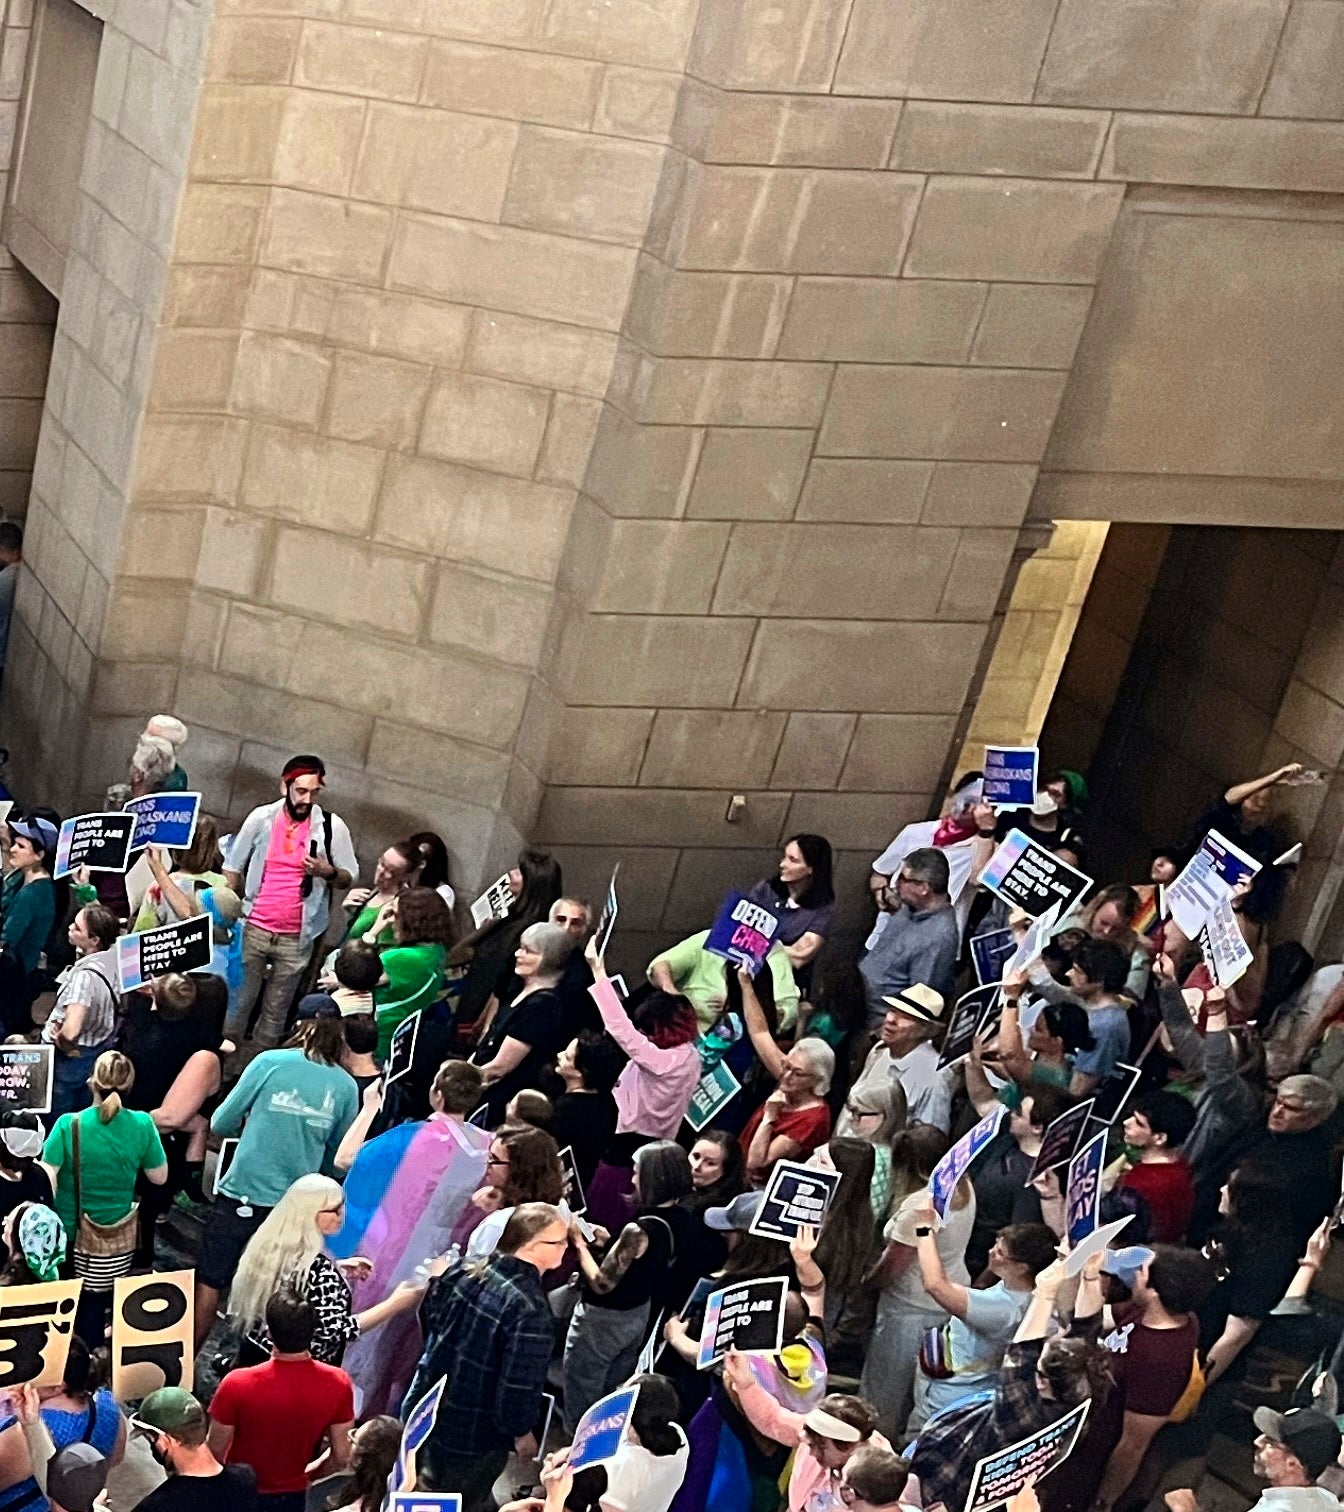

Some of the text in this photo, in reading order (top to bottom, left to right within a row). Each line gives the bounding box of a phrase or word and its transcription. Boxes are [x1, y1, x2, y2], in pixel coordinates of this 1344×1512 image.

[143, 930, 178, 944] TRANS
[143, 932, 202, 954] PEOPLE ARE
[144, 948, 186, 962] HERE TO
[2, 1052, 40, 1064] TRANS
